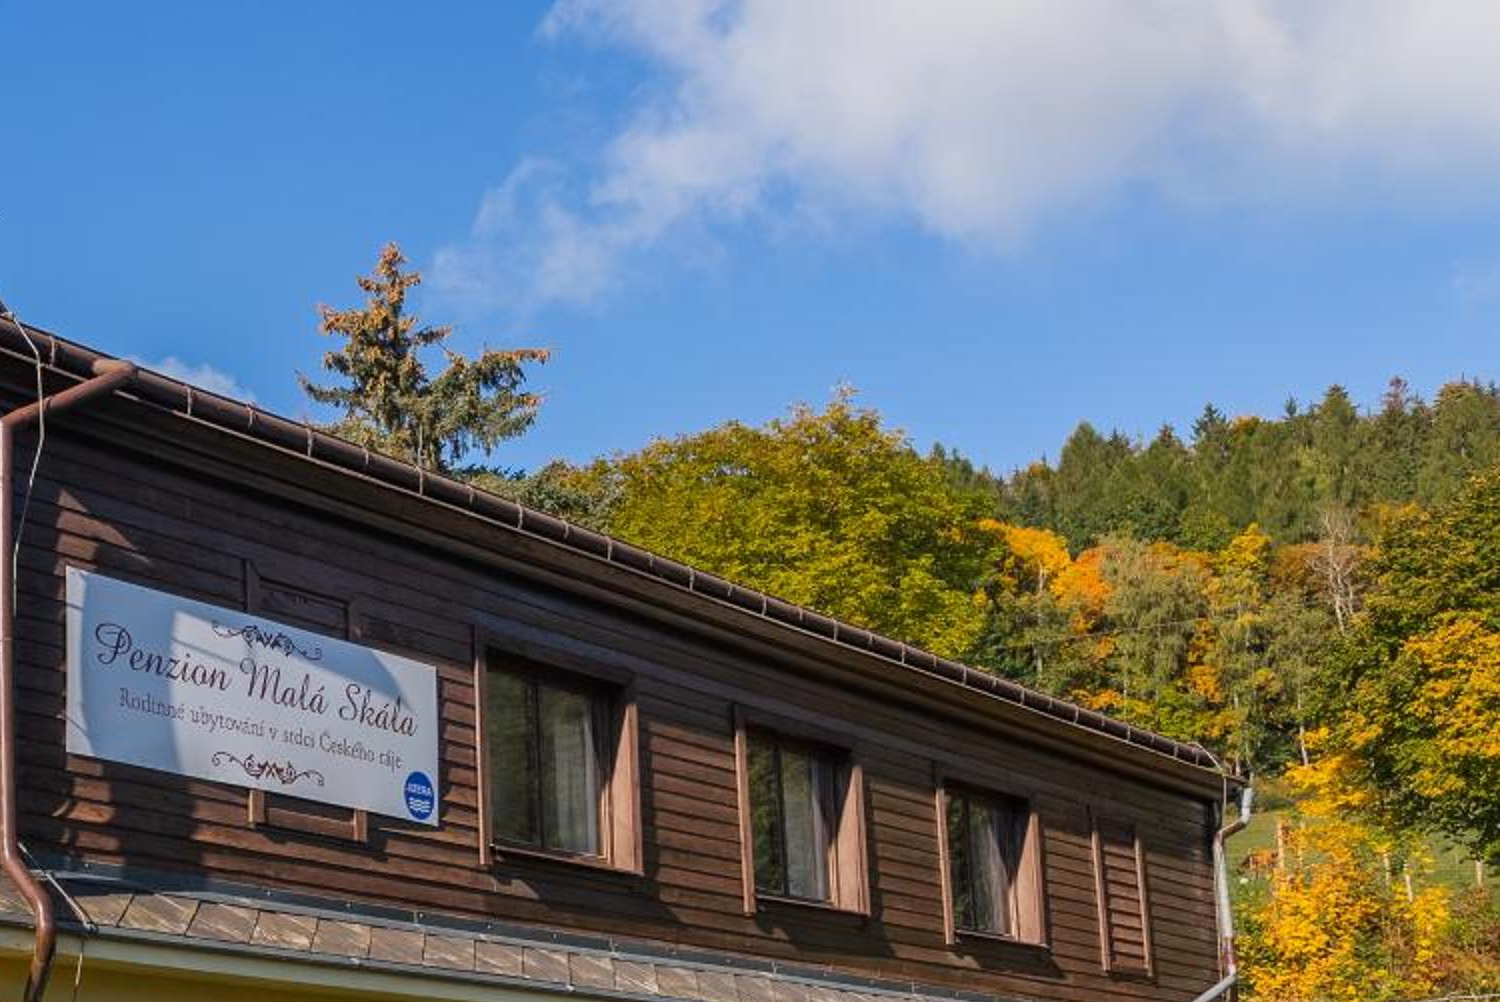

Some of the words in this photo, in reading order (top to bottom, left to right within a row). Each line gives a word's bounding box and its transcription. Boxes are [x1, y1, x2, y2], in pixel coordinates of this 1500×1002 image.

[95, 623, 232, 691] Penzion
[240, 658, 329, 715] Malá
[339, 684, 418, 737] Skála
[119, 687, 185, 721] Rodinné
[189, 705, 264, 737] ubytování
[269, 726, 278, 741] v
[319, 730, 375, 762] Českého
[379, 748, 403, 773] ráje
